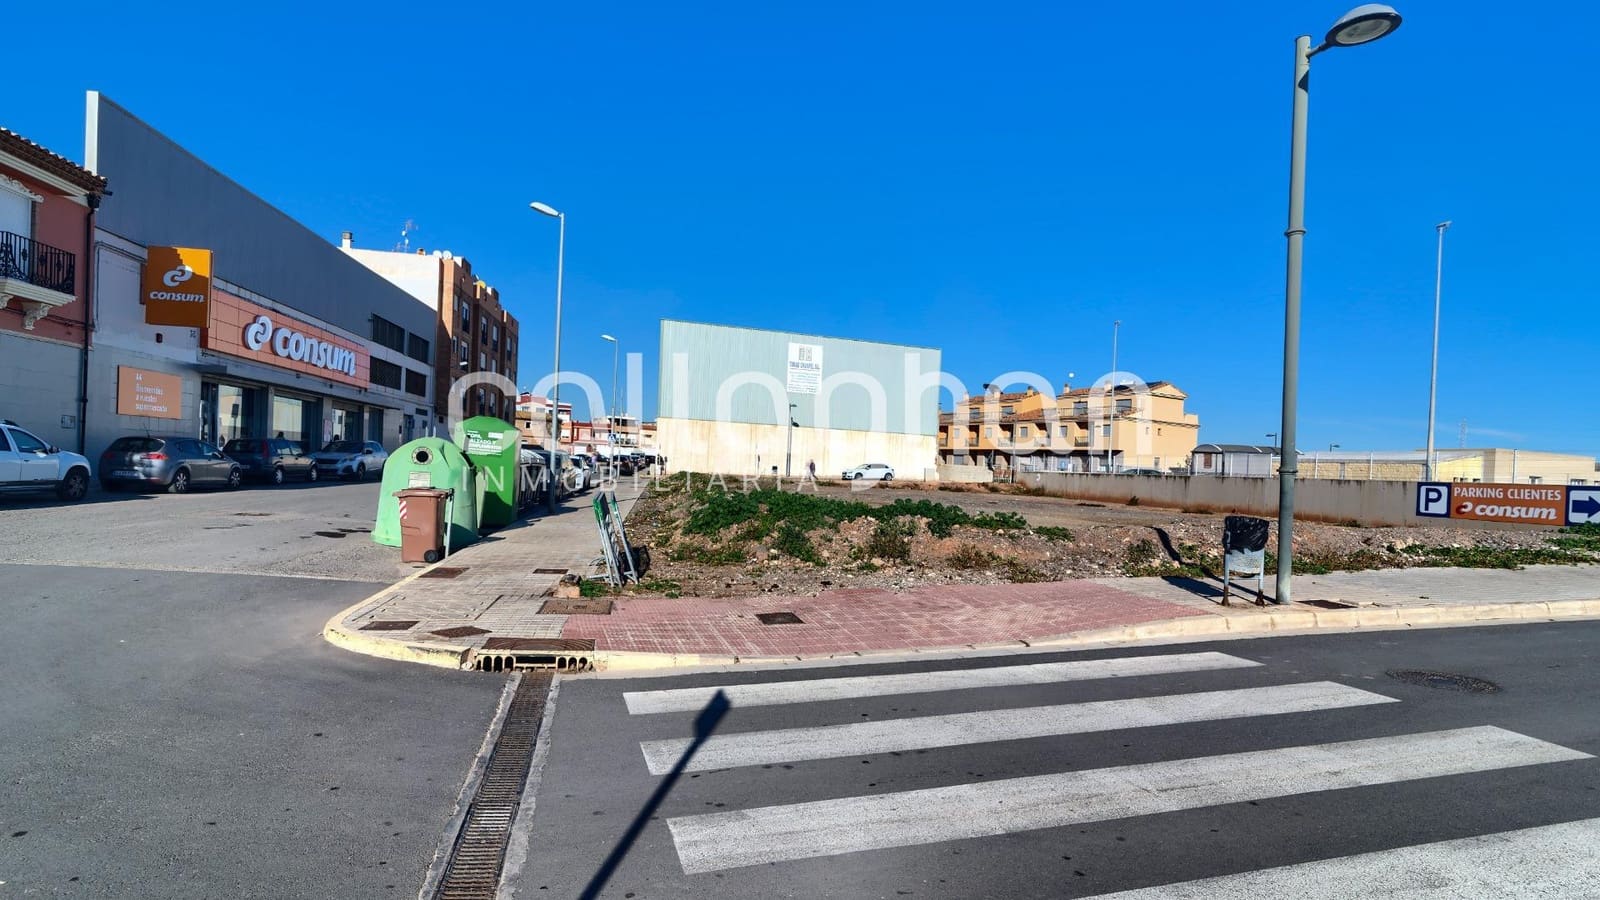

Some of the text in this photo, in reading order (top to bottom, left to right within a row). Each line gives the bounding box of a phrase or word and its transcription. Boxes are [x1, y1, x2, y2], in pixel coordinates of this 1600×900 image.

[150, 291, 204, 303] consum
[272, 327, 356, 377] consum
[1424, 487, 1443, 512] P
[1454, 487, 1562, 501] PARKING CLIENTES
[1474, 504, 1557, 520] consum
